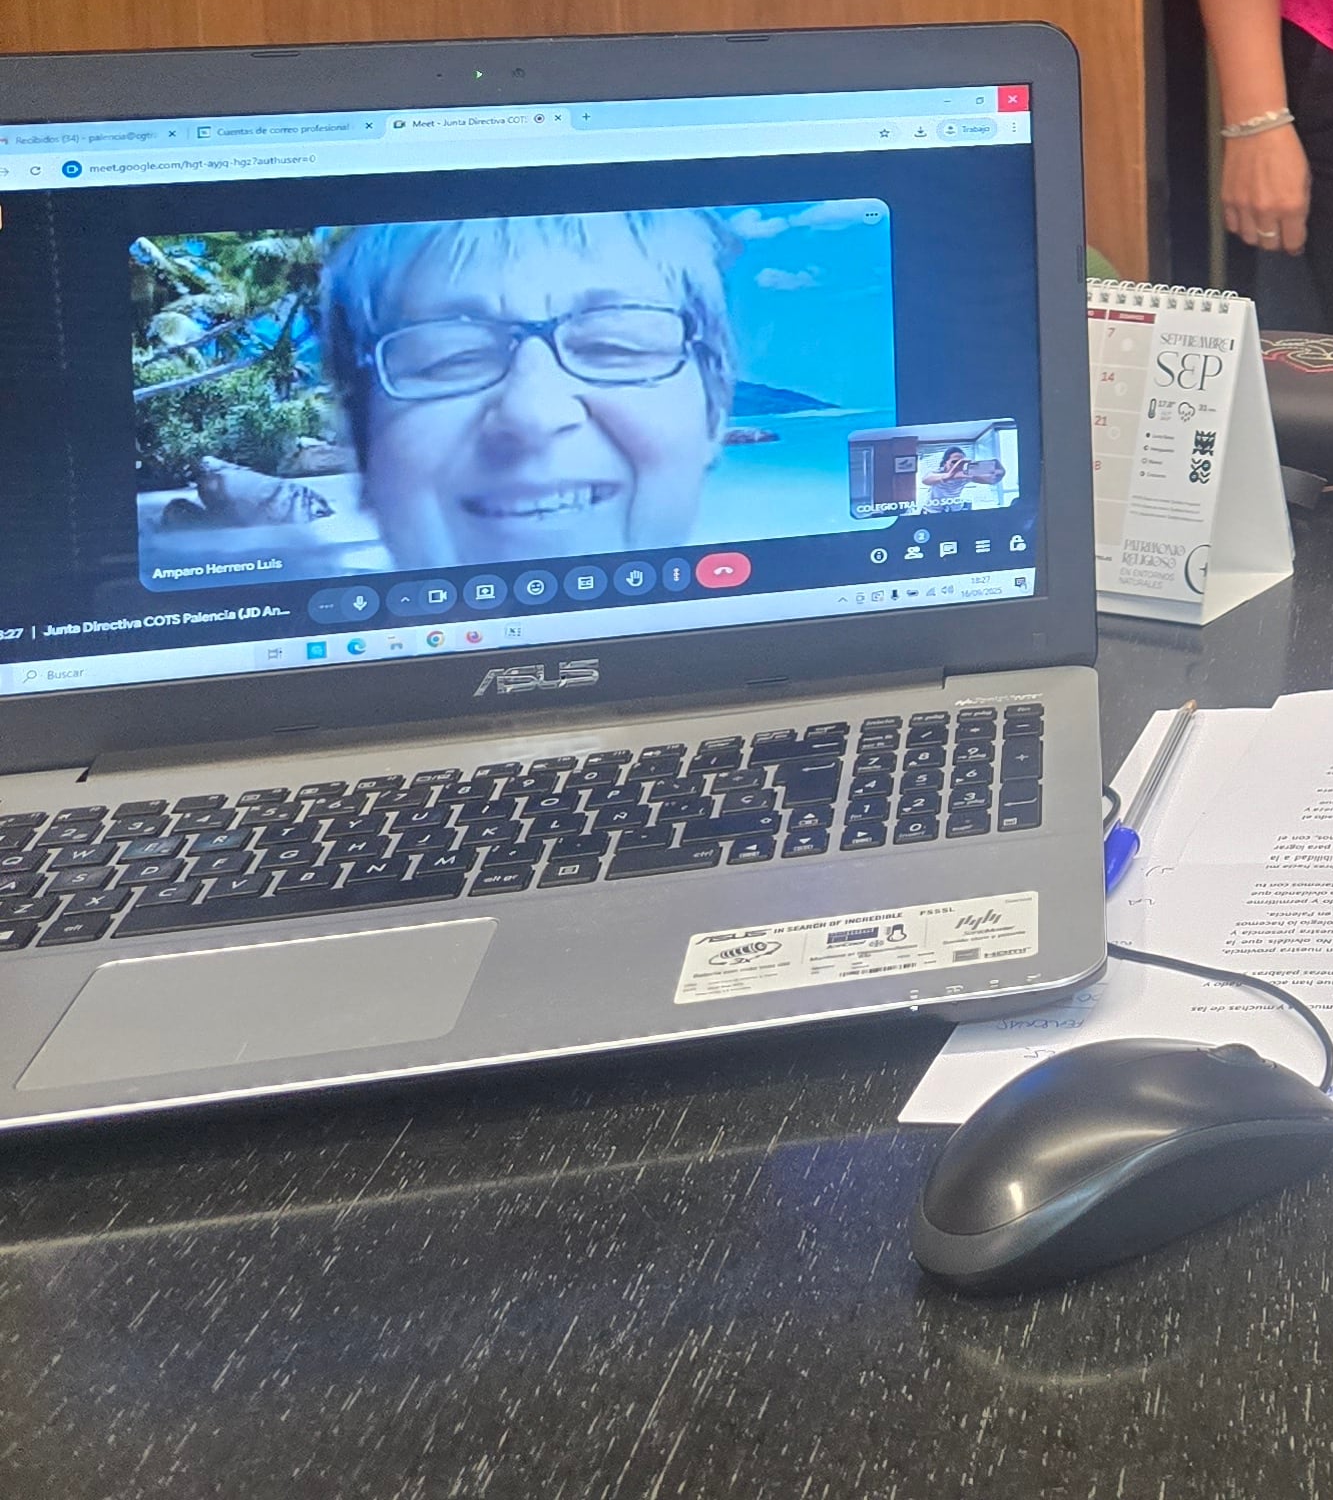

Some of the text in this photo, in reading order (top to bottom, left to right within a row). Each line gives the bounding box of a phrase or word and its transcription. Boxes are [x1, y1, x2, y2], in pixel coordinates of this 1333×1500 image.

[412, 120, 436, 128] Meet
[442, 118, 466, 127] Junta
[467, 117, 506, 127] Directiva
[217, 124, 350, 137] Cuentas de correo profesional
[961, 125, 991, 134] Trabajo
[1108, 327, 1116, 338] 7
[1160, 333, 1229, 353] SEPTIEMBRE
[1154, 350, 1223, 391] SEP
[1101, 372, 1115, 382] 14
[1094, 415, 1108, 426] 21
[856, 502, 898, 513] COLEGIO
[1123, 539, 1186, 557] PATRIMONIO
[1121, 553, 1177, 569] RELIGIOSO
[152, 557, 283, 580] Amparo Herrero Luis
[1120, 567, 1175, 582] EN ENTORNOS
[1119, 577, 1164, 590] NATURALES
[43, 623, 81, 637] Junta
[83, 617, 142, 633] Directiva
[143, 613, 181, 627] COTS
[183, 609, 237, 624] Palencia
[46, 667, 84, 680] Buscar
[472, 658, 600, 697] ASUS
[72, 850, 97, 860] W
[433, 855, 457, 866] M
[366, 863, 387, 874] N
[71, 873, 90, 883] S
[774, 927, 785, 935] IN
[786, 921, 828, 933] SEARCH
[829, 920, 843, 928] OF
[844, 911, 904, 926] INCREDIBLE
[1222, 946, 1277, 956] provincia,
[1229, 1002, 1275, 1012] muchas
